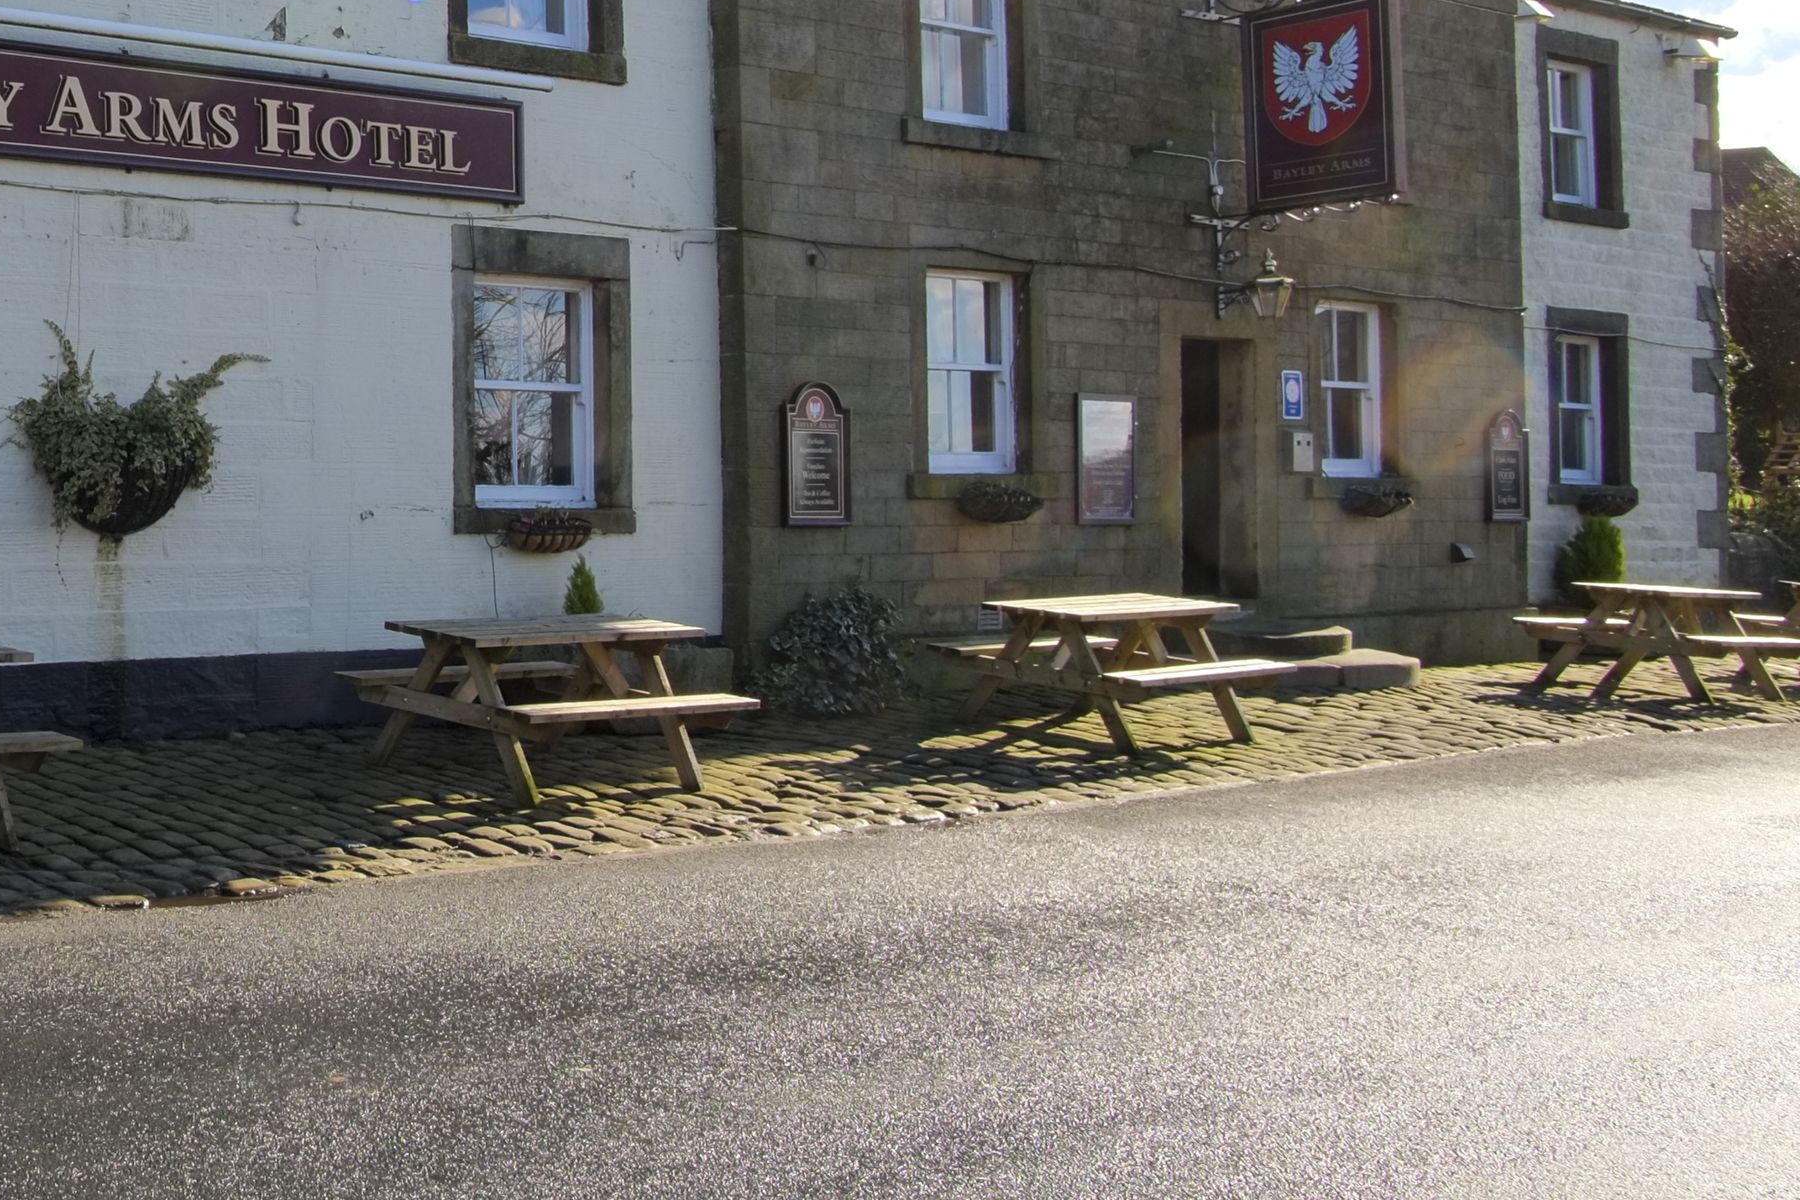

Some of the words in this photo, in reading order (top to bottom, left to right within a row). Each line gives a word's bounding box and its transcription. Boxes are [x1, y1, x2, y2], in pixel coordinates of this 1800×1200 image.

[40, 74, 241, 150] ARMS
[255, 97, 473, 176] HOTEL
[1272, 163, 1325, 181] BAYLEY
[1330, 156, 1372, 172] ARMS
[802, 470, 831, 480] Welcome
